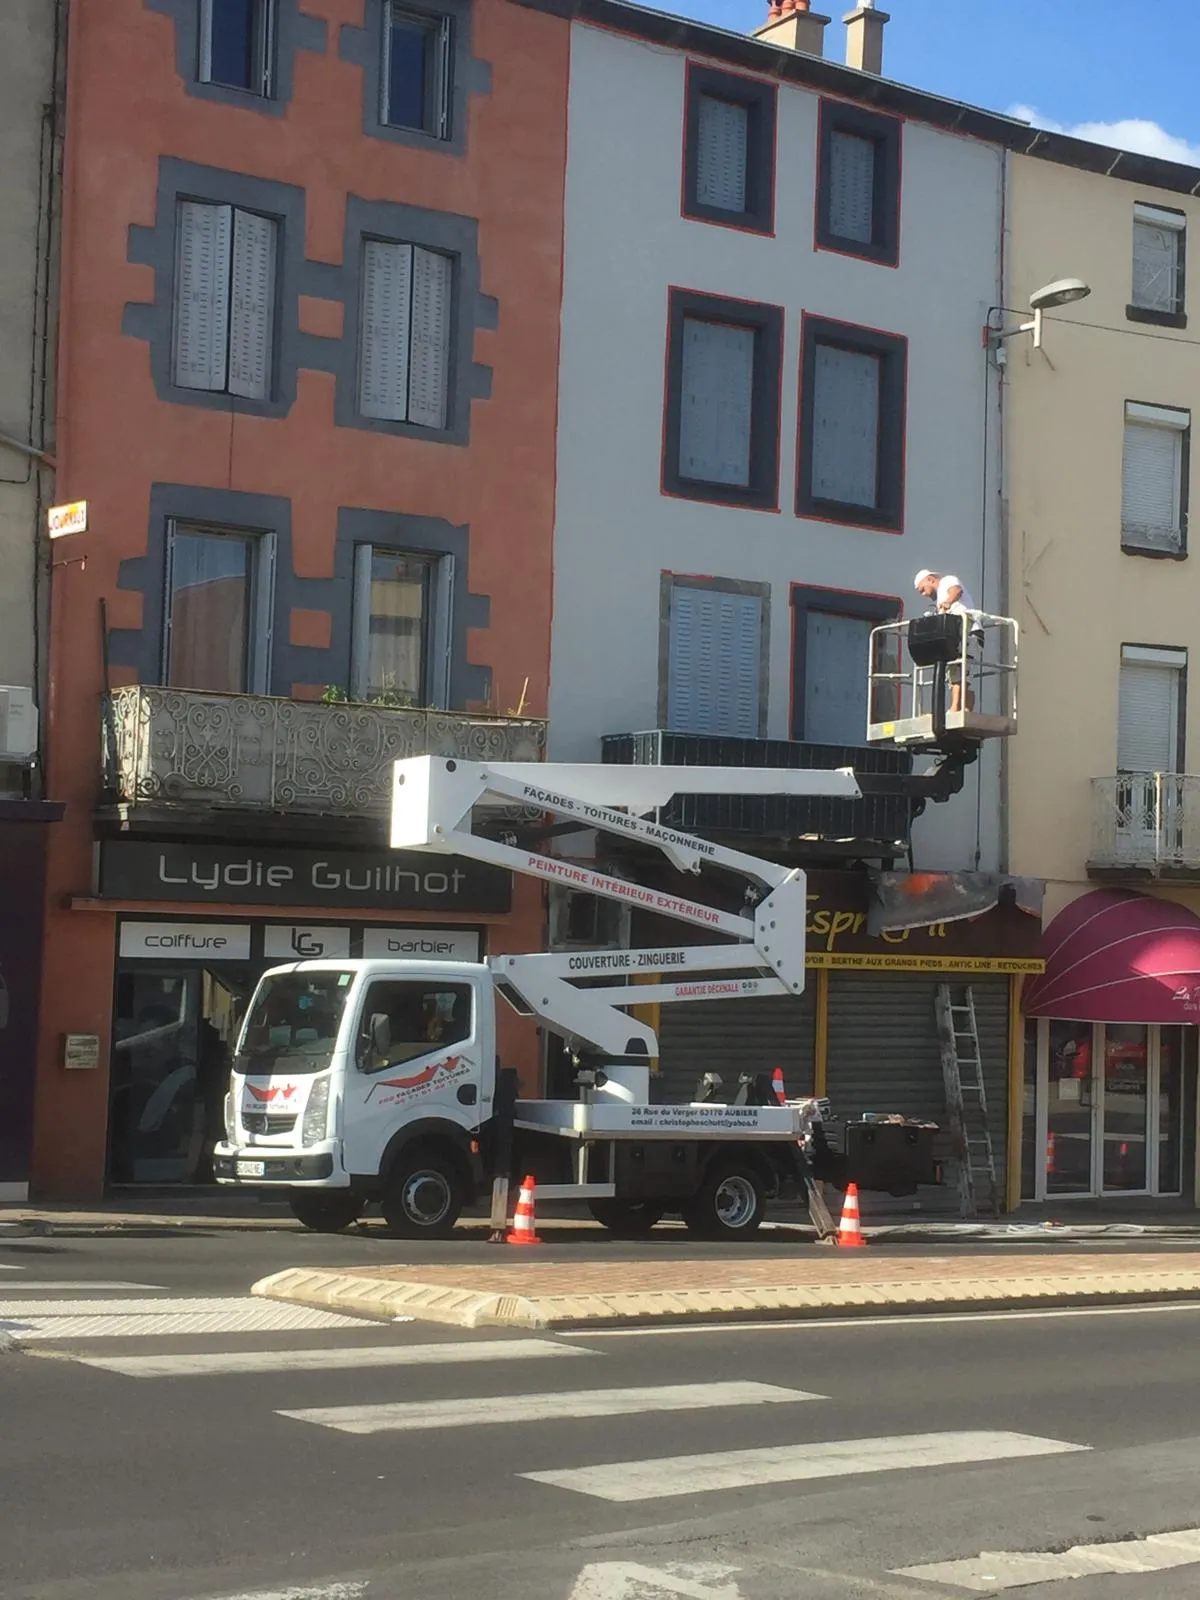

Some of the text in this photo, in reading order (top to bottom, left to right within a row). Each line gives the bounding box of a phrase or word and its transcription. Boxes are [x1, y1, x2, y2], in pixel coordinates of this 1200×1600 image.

[524, 786, 574, 810] FAÇADES
[584, 805, 637, 830] TOITURES
[646, 825, 715, 856] MAÇONNERIE
[159, 855, 466, 894] Lydie Guilhot
[528, 857, 588, 883] PEINTURE
[144, 934, 228, 950] coiffure
[387, 938, 456, 955] barbier
[569, 954, 631, 970] COUVERTURE
[638, 952, 686, 967] ZINGUERIE
[884, 958, 918, 967] GRANDS
[672, 1108, 697, 1117] Verger
